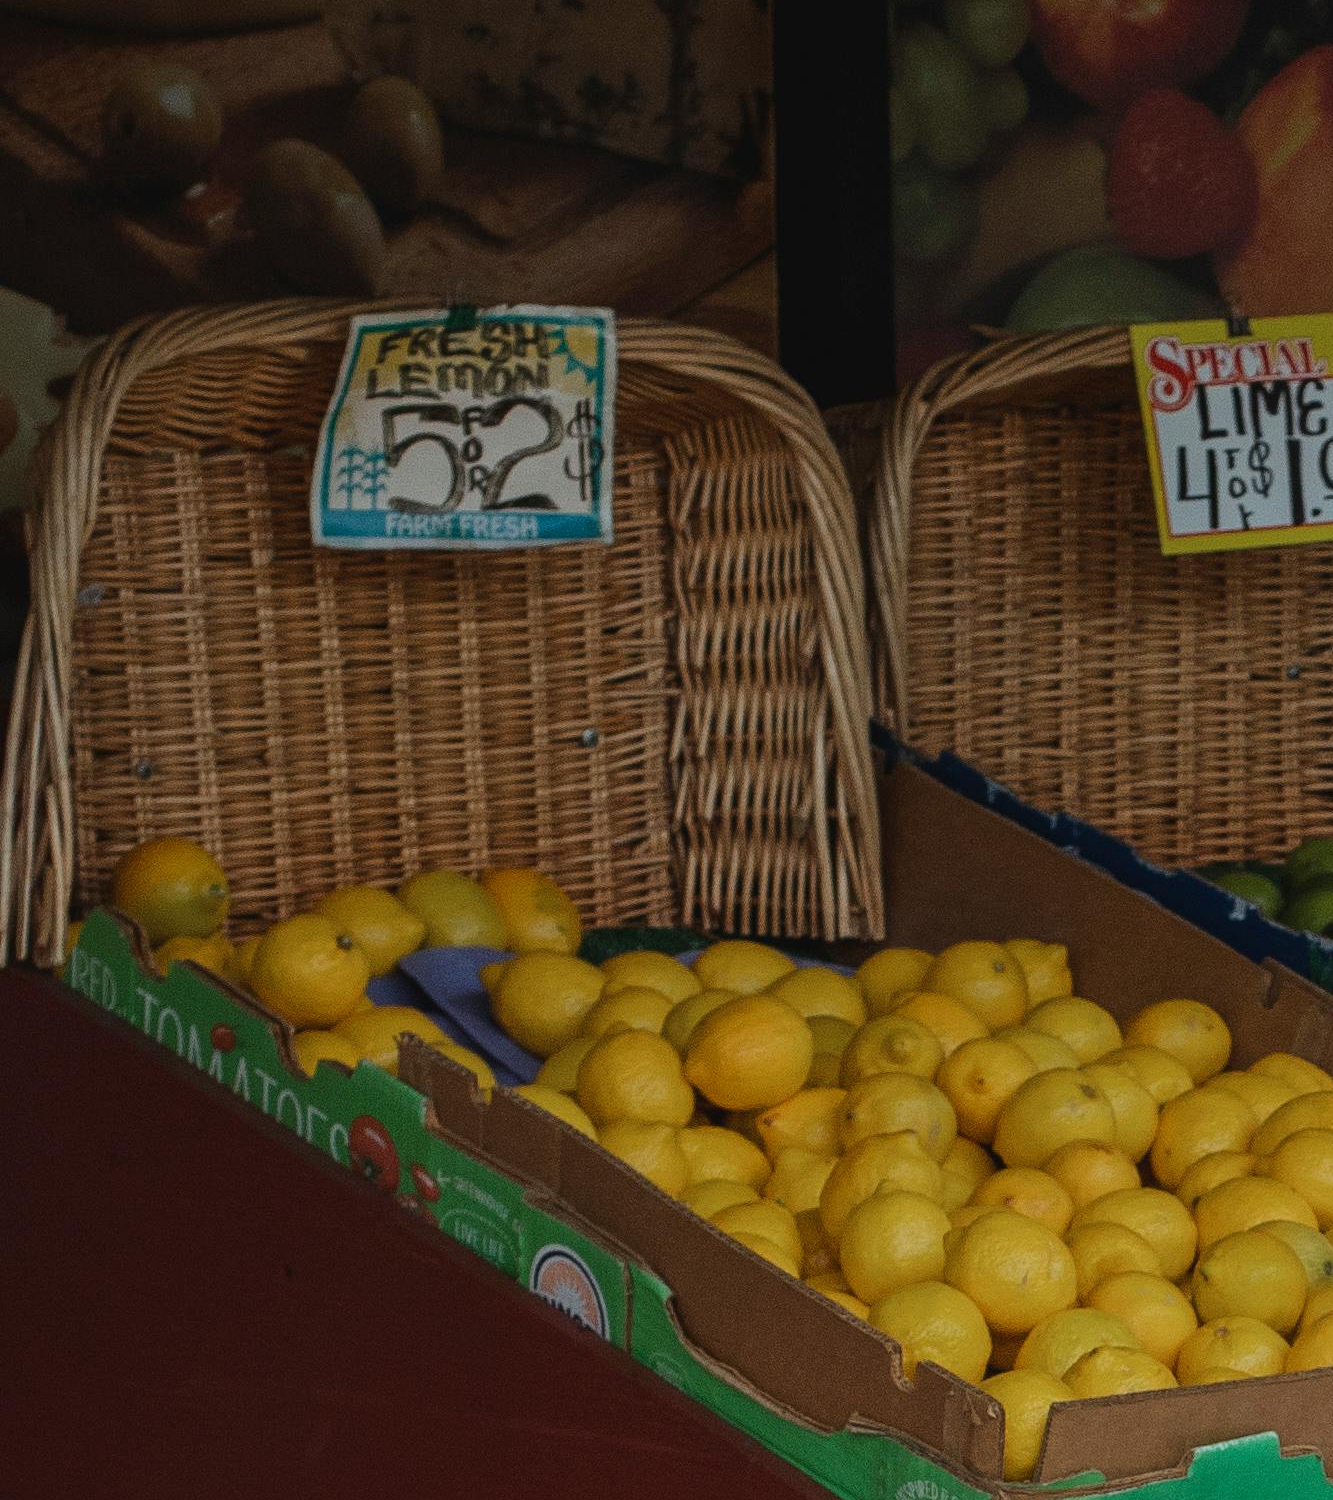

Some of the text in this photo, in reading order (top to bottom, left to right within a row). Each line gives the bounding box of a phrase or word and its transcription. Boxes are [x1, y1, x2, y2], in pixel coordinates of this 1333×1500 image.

[379, 321, 551, 364] FRESH
[1147, 336, 1329, 413] SPECIAL
[365, 362, 551, 400] LEMON
[1196, 377, 1328, 441] LIME
[381, 402, 466, 513] 5
[1176, 445, 1219, 529] 4
[459, 512, 540, 538] FRESH
